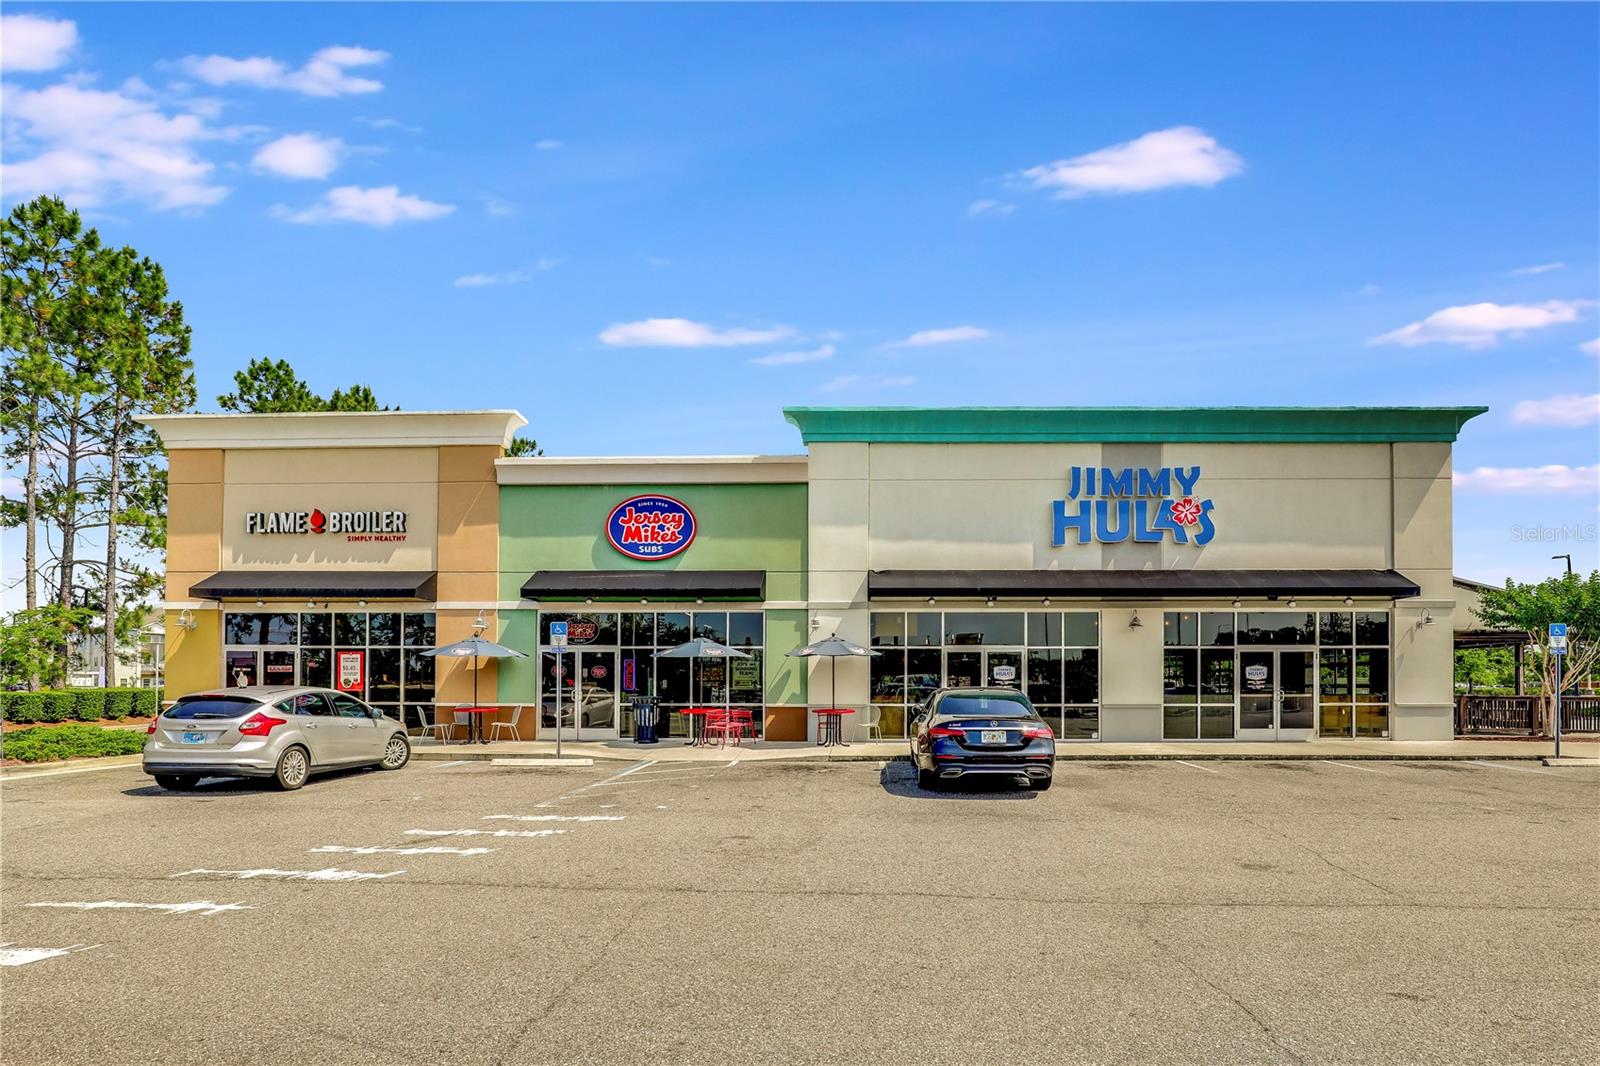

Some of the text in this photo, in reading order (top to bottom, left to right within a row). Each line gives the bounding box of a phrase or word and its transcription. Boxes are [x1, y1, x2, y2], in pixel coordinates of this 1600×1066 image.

[1067, 466, 1201, 500] JIMMY
[246, 510, 408, 535] FLAME BROILER
[619, 507, 685, 530] Jersey
[347, 535, 408, 543] SIMPLY HEALTHY
[621, 525, 683, 545] Mike's
[638, 545, 663, 554] SUBS
